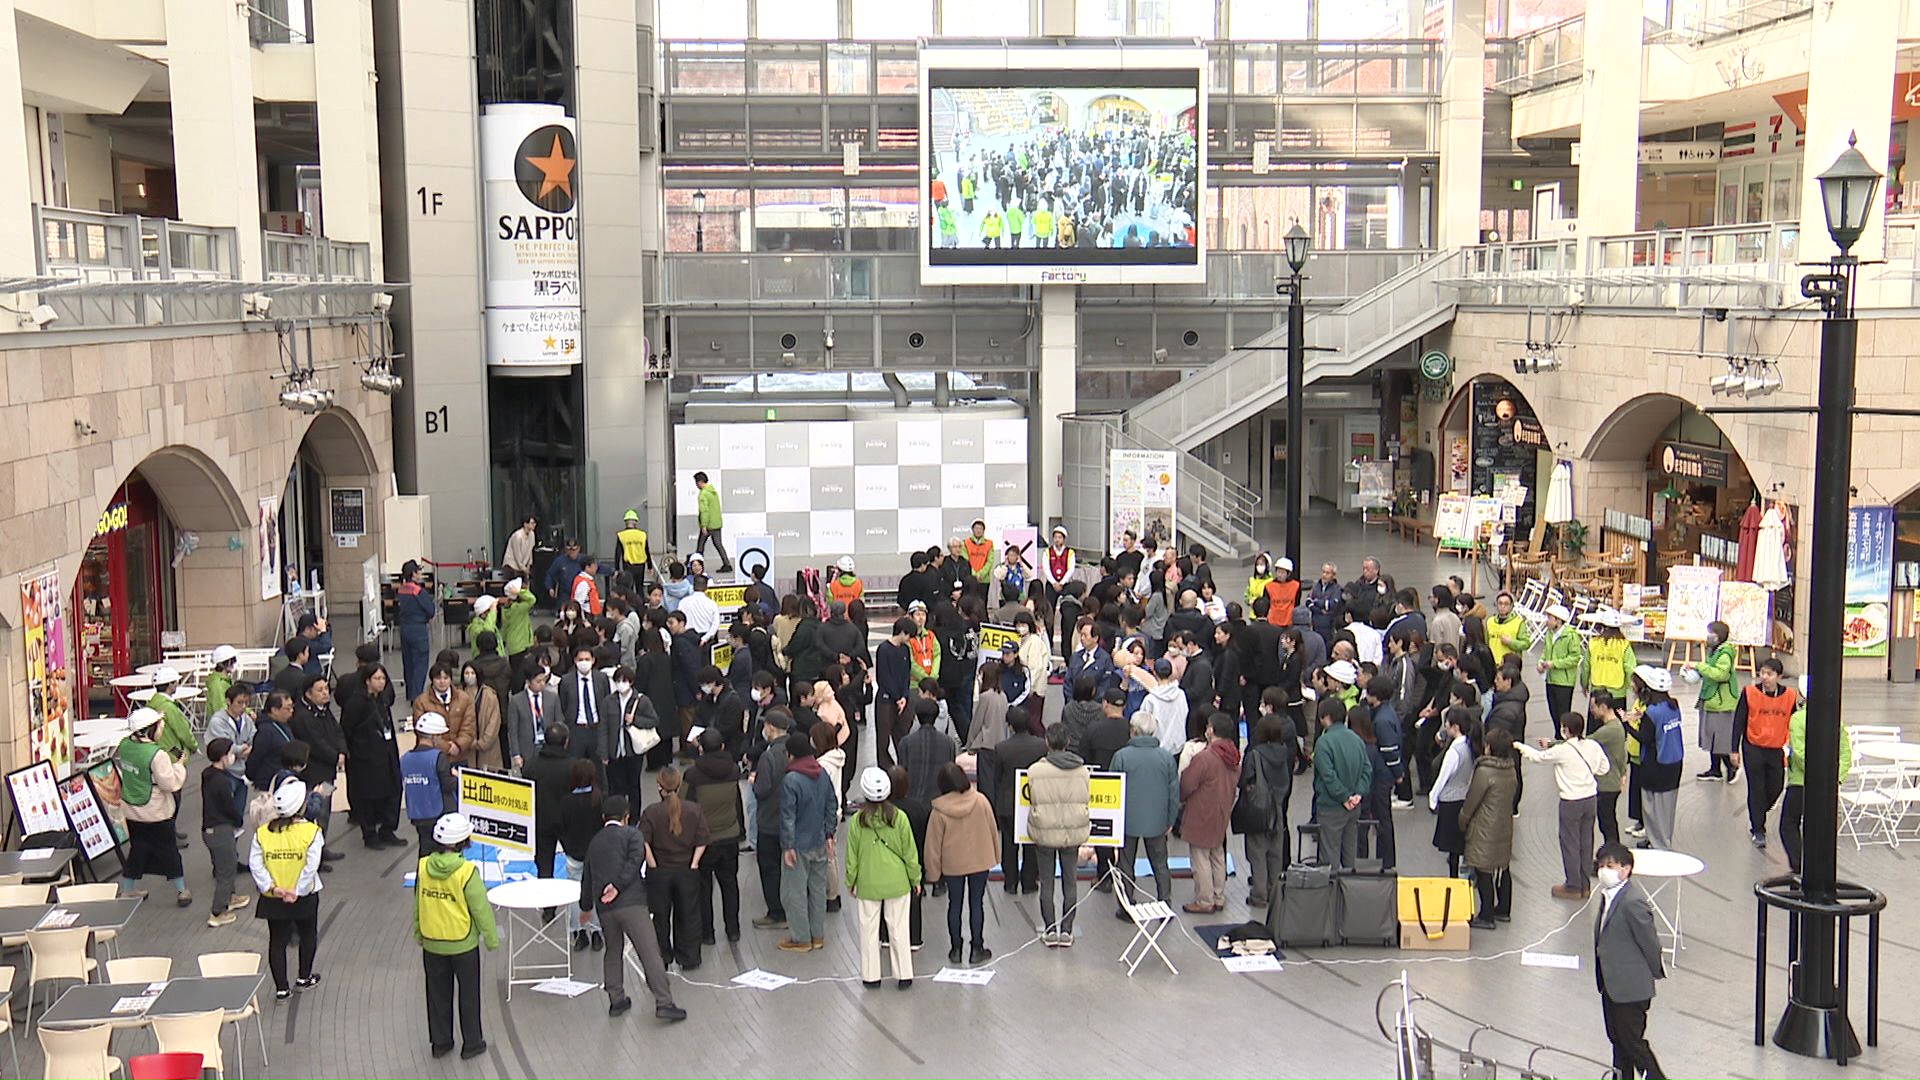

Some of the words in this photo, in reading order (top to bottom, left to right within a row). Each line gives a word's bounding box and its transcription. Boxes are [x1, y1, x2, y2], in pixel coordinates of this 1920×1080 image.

[417, 186, 444, 216] 1F
[498, 214, 579, 241] SAPPO
[425, 405, 449, 434] B1
[1122, 452, 1165, 460] INFORMATION
